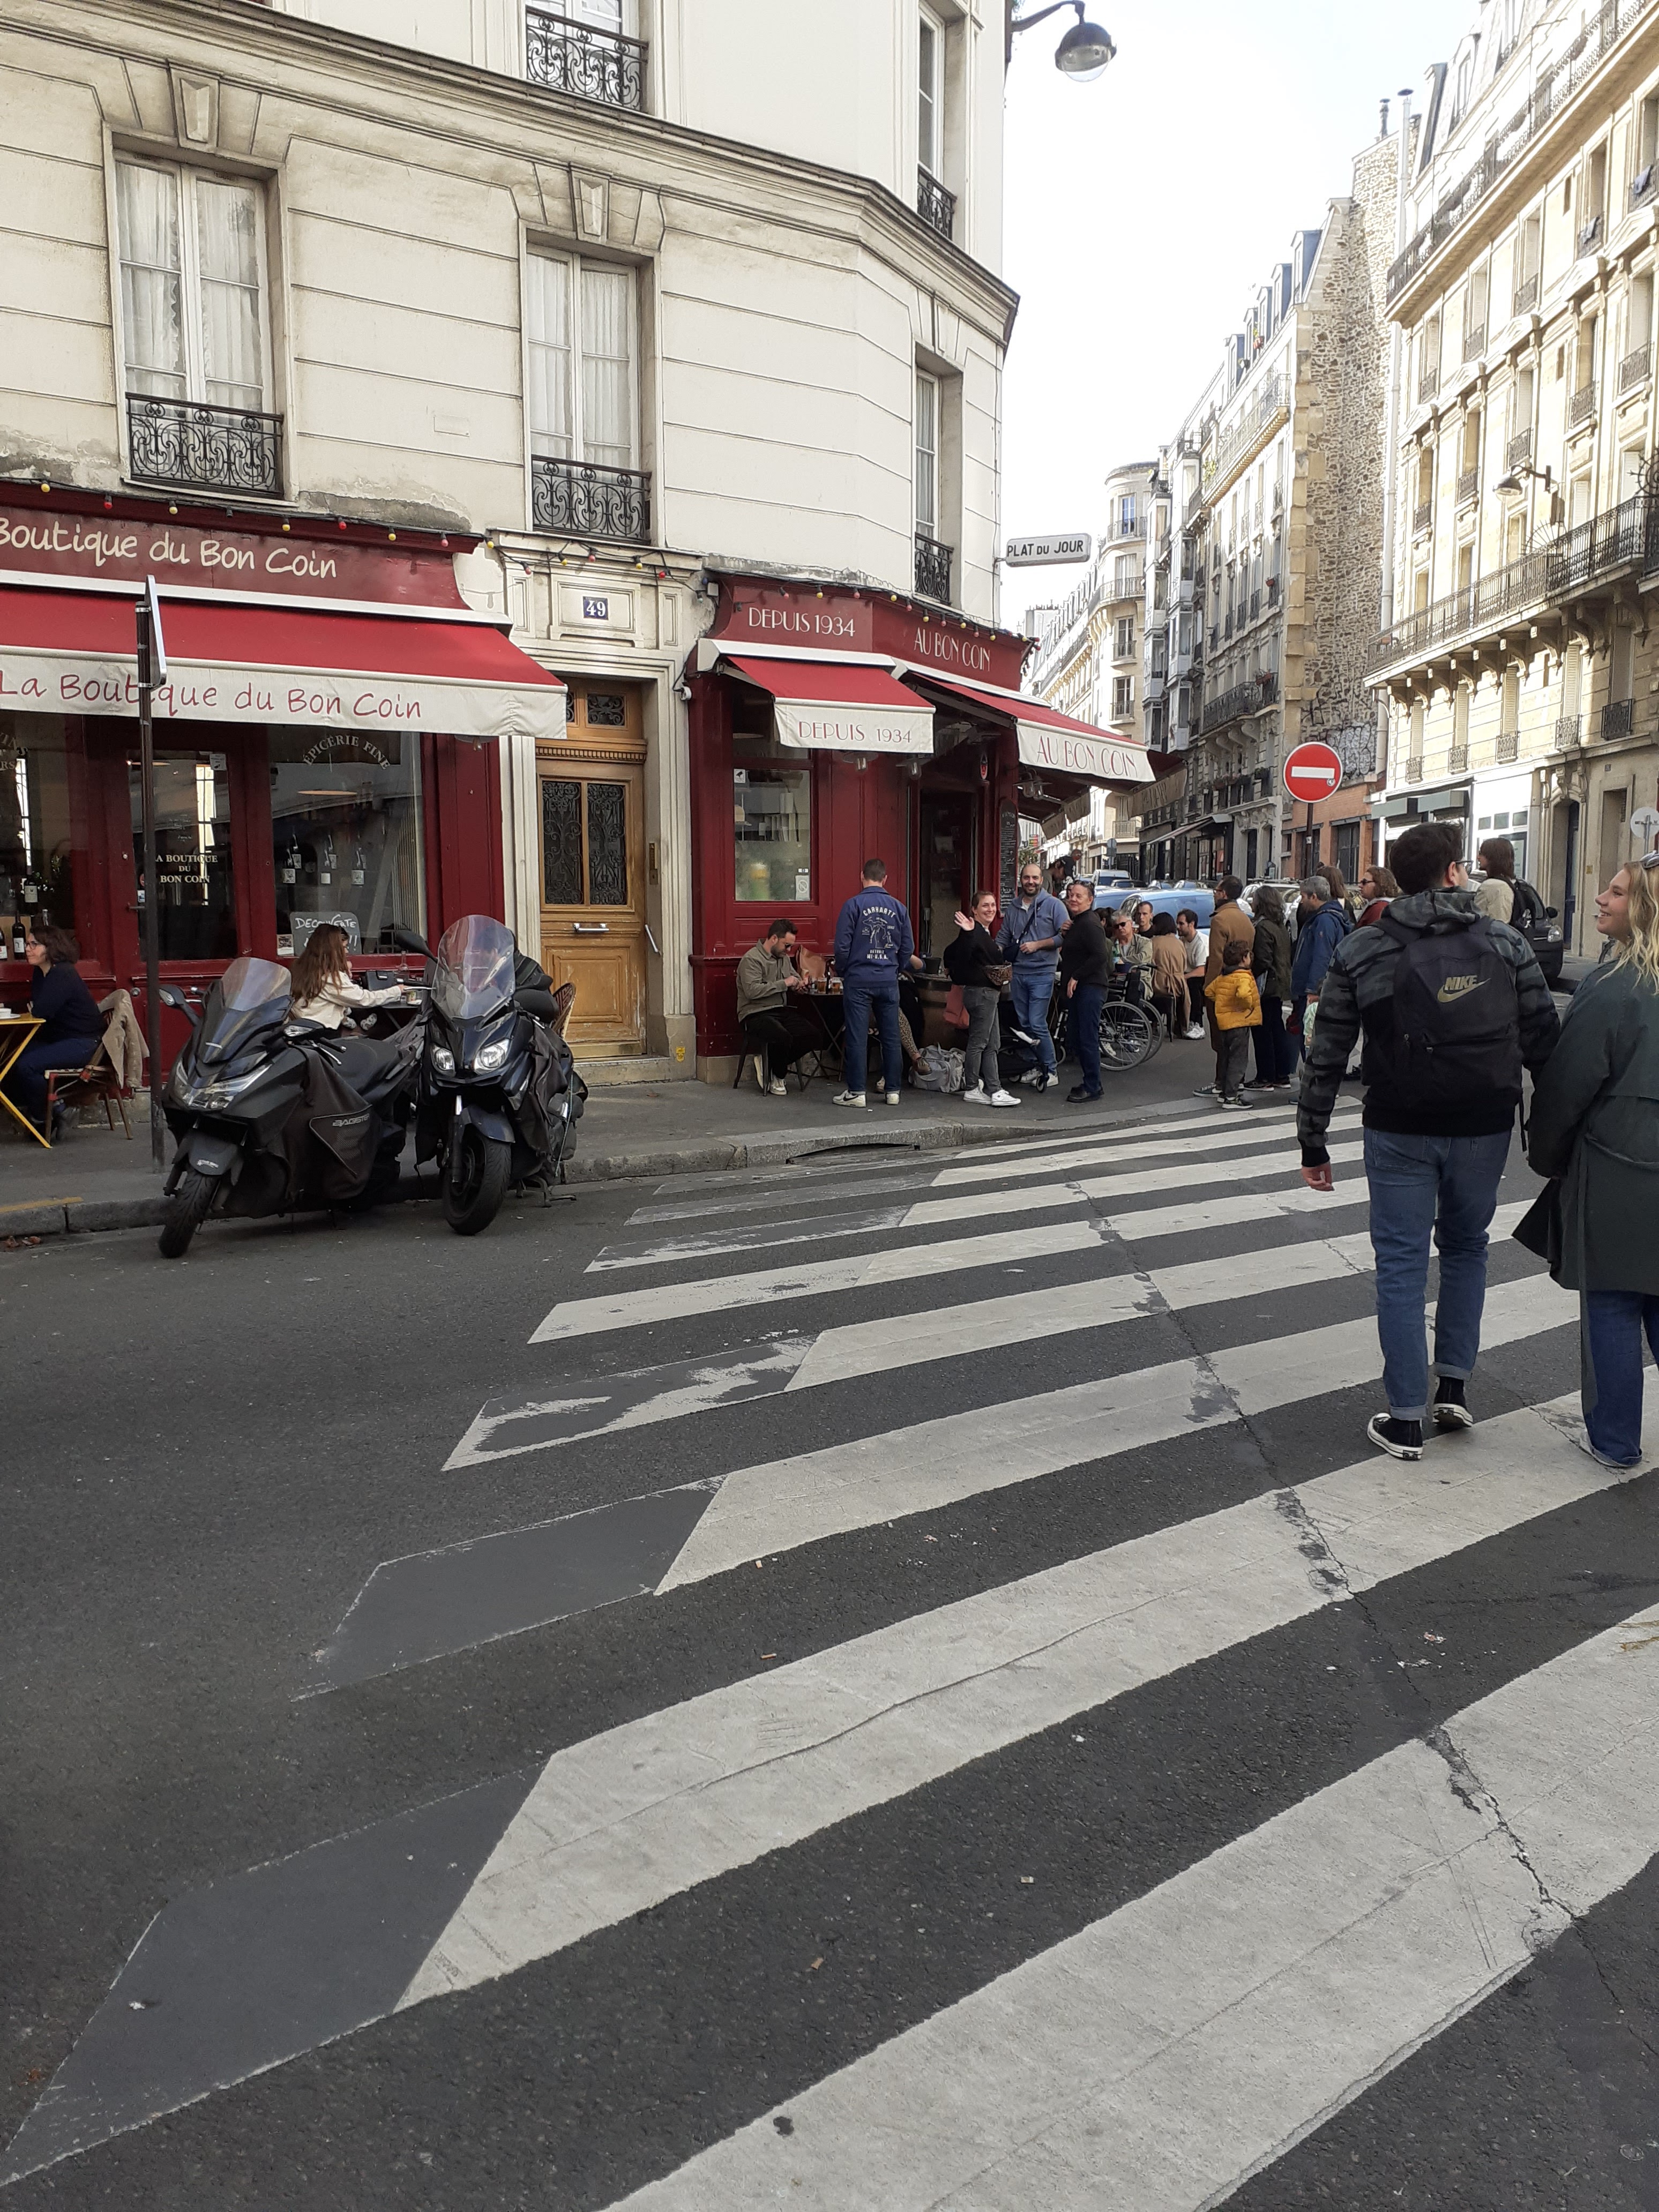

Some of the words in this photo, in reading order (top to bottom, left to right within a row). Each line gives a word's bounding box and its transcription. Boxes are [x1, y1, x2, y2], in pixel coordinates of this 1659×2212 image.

[0, 517, 137, 566] Boutique
[149, 532, 190, 565] du
[200, 540, 254, 570] Bon
[265, 548, 337, 579] Coin
[1007, 543, 1034, 557] PLAT
[1036, 544, 1049, 554] DU
[1054, 540, 1083, 554] JOUR
[586, 599, 607, 616] 49
[749, 607, 810, 633] DEPUIS
[815, 615, 855, 637] 1934
[914, 627, 932, 655] AU
[934, 633, 959, 662] BON
[962, 641, 991, 672] COIN
[0, 670, 47, 698] La
[60, 674, 218, 716] Boutque
[235, 683, 274, 711] du
[288, 689, 341, 715] Bon
[353, 693, 421, 719] Coin
[798, 721, 865, 741] DEPUIS
[877, 728, 912, 743] 1934
[363, 739, 390, 770] FINE
[1037, 735, 1059, 765] AU
[1064, 741, 1095, 770] BON
[1101, 748, 1138, 777] COIN
[166, 855, 218, 864] BOUTIQUE
[160, 875, 182, 883] BON
[185, 875, 211, 883] COIN
[863, 906, 896, 918] CARHARTT
[1444, 975, 1478, 990] NIKE
[332, 1114, 370, 1126] BAGSTER
